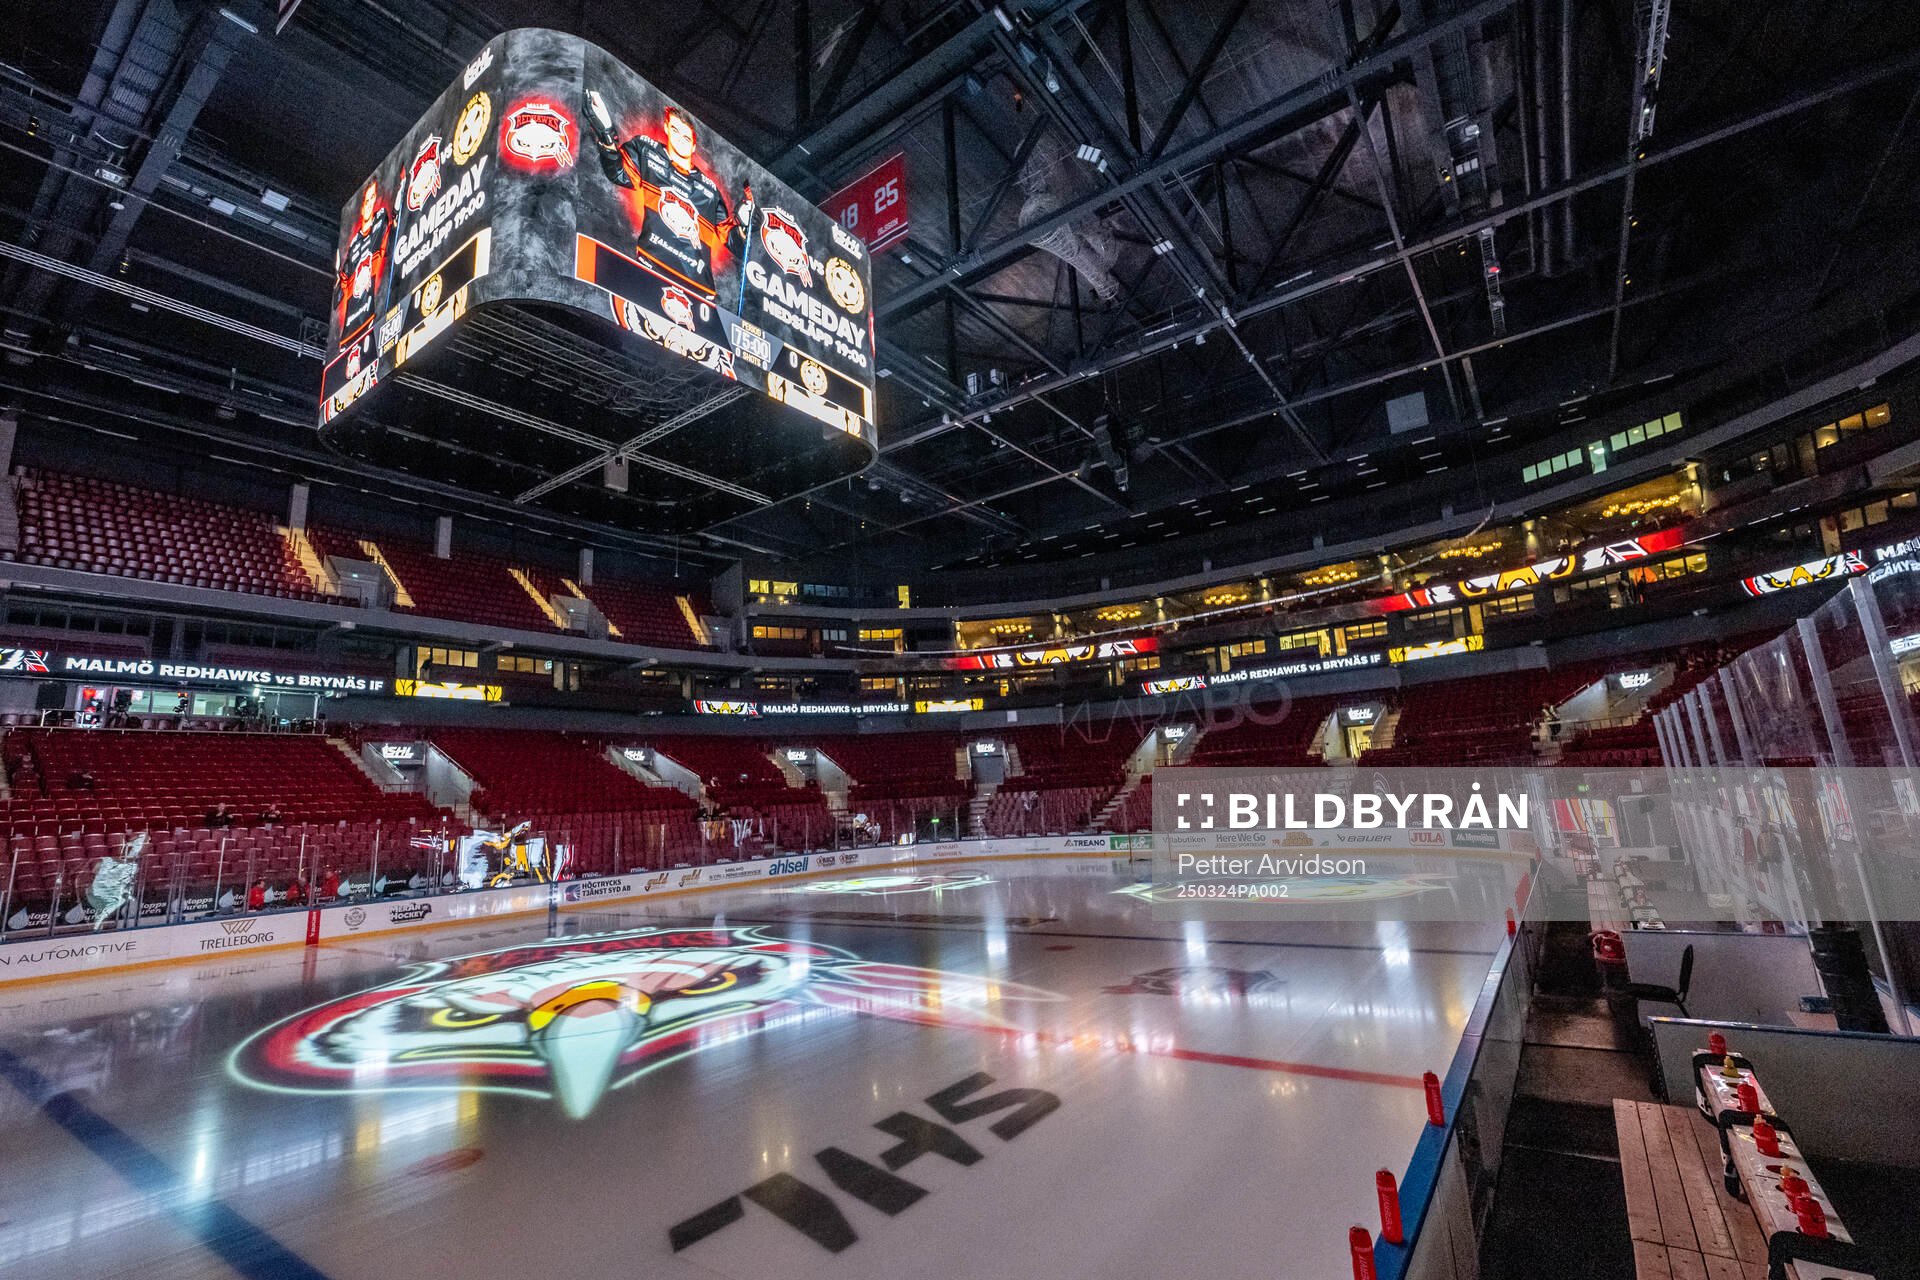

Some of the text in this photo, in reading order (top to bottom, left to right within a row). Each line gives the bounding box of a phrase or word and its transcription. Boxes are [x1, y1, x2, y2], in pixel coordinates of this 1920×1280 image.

[516, 114, 560, 130] REDHAWKS
[874, 177, 899, 214] 25
[394, 155, 489, 264] GAMEDAY
[454, 191, 486, 230] 19:00
[840, 203, 858, 229] 18
[745, 261, 866, 349] GAMEDAY
[763, 297, 867, 368] NEDSLÄPP 19:00
[734, 327, 769, 359] 75:00
[789, 351, 798, 369] 0
[66, 657, 384, 692] MALMÖ REDHAWKS vs BRYNÄS IF
[1210, 653, 1382, 685] MALMÖ REDHAWKS vs BRYNÄS IF
[762, 703, 798, 713] MALMÖ
[800, 705, 850, 713] REDHAWKS
[863, 702, 899, 713] BRYNÄS
[901, 703, 909, 712] IF
[381, 743, 414, 759] SHL
[1073, 839, 1106, 847] TREANO
[1216, 834, 1236, 843] Here
[1237, 833, 1252, 842] We
[1253, 832, 1266, 842] Go
[1410, 831, 1444, 843] JULA
[769, 857, 809, 876] ahlsell
[582, 879, 622, 890] HÖGTRYCKS
[582, 887, 607, 897] TJÄNST
[390, 909, 425, 921] HOCKEY
[200, 931, 275, 950] TRELLEBORG
[17, 940, 138, 965] AUTOMOTIVE
